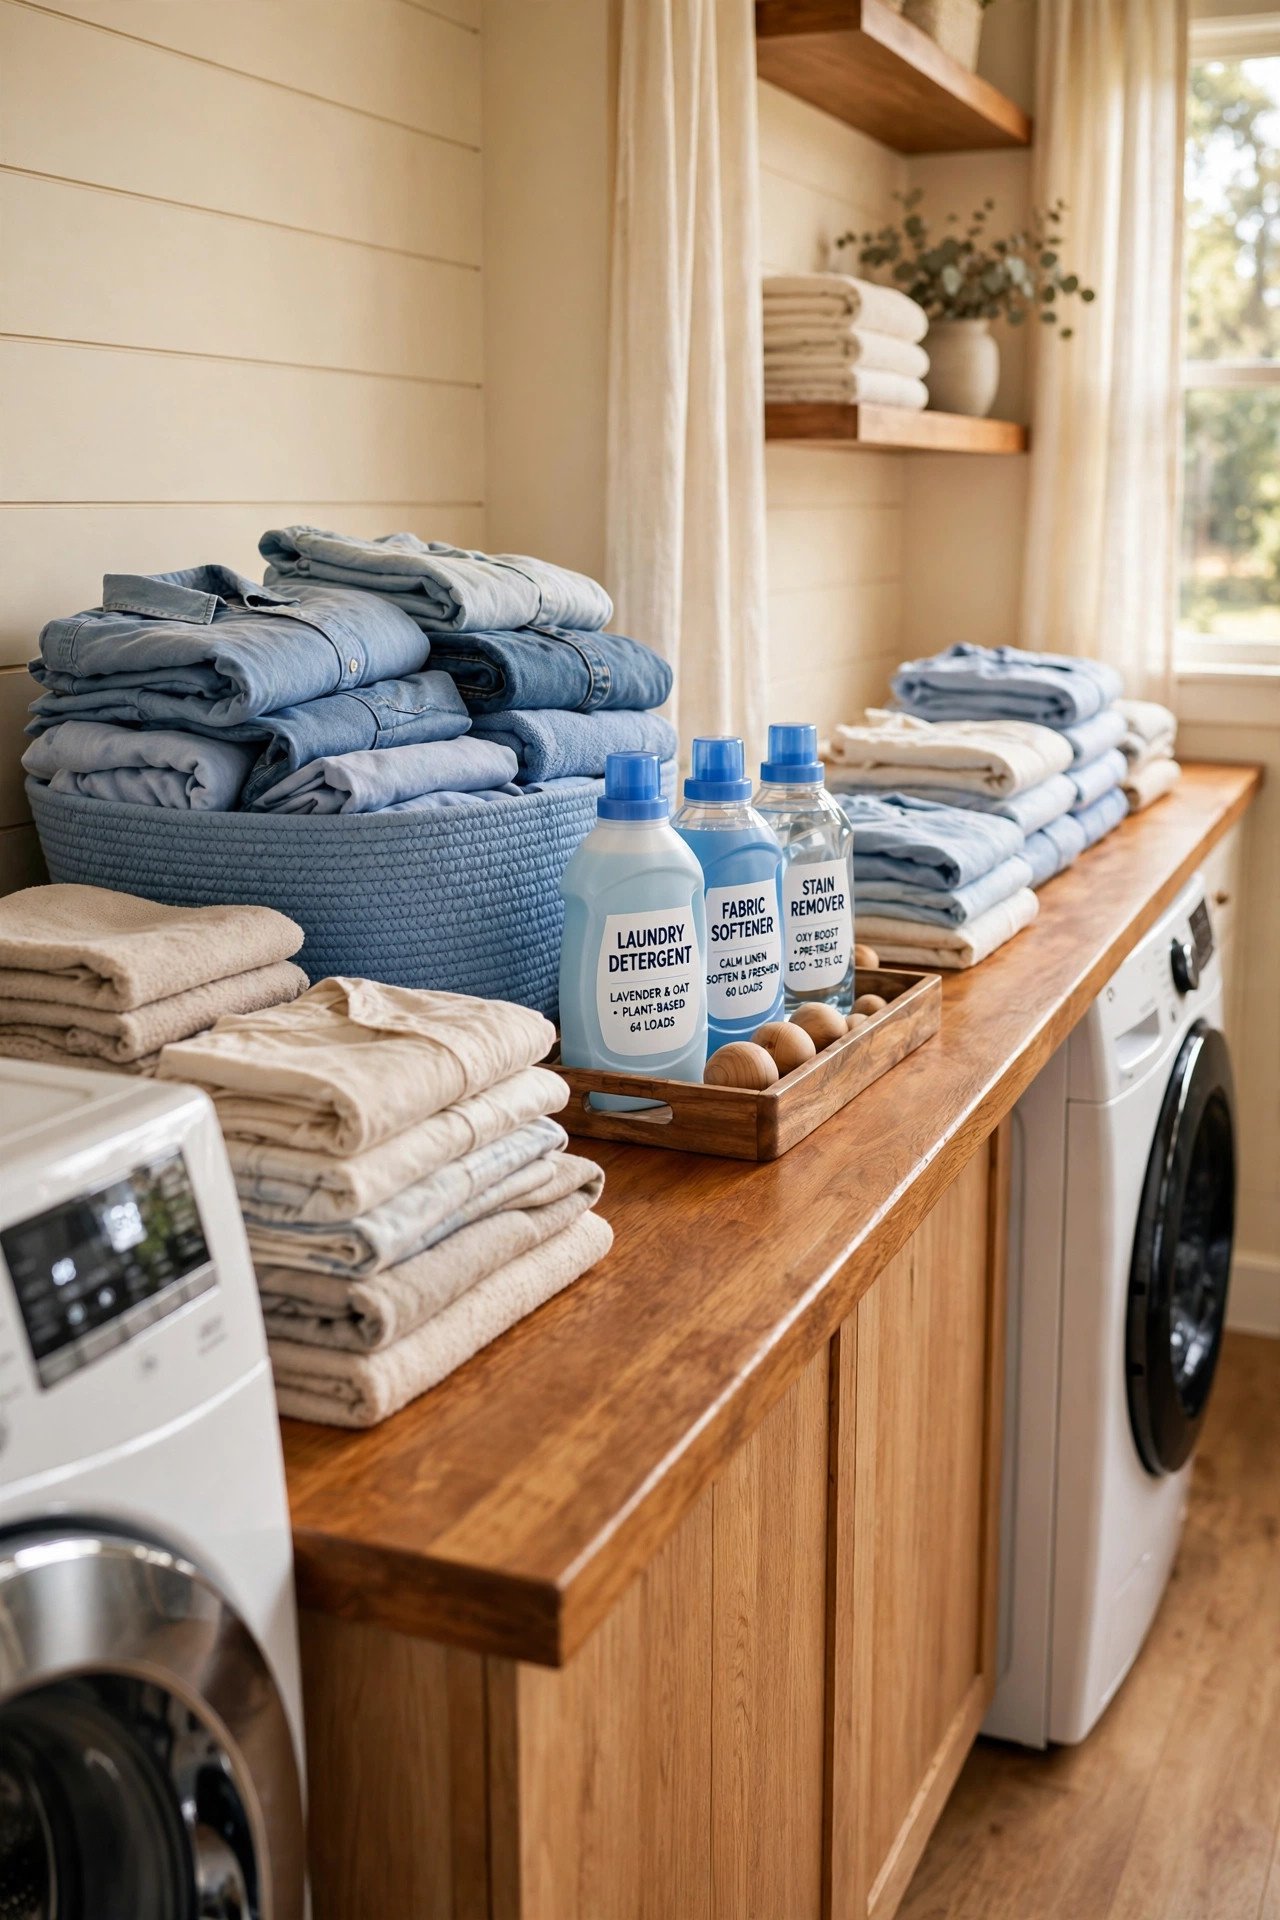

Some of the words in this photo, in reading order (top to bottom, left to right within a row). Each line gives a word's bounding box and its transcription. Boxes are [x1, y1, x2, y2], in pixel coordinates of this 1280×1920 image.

[802, 876, 835, 896] STAIN
[722, 896, 766, 920] FABRIC
[791, 894, 845, 917] REMOVER
[617, 923, 685, 950] LAUNDRY
[711, 916, 774, 942] SOFTENER
[795, 932, 813, 943] OXY
[814, 927, 839, 940] BOOST
[608, 945, 692, 973] DETERGENT
[719, 956, 742, 969] CALM
[744, 951, 767, 966] LINEN
[788, 961, 806, 972] ECO
[706, 971, 739, 985] SOFTEN
[610, 987, 662, 1003] LAVENDER
[664, 986, 670, 997] &
[672, 982, 690, 995] OAT
[725, 986, 737, 998] 60
[738, 981, 763, 996] LOADS
[622, 999, 686, 1018] PLANT-BASED
[630, 1022, 642, 1033] 64
[644, 1016, 675, 1032] LOADS
